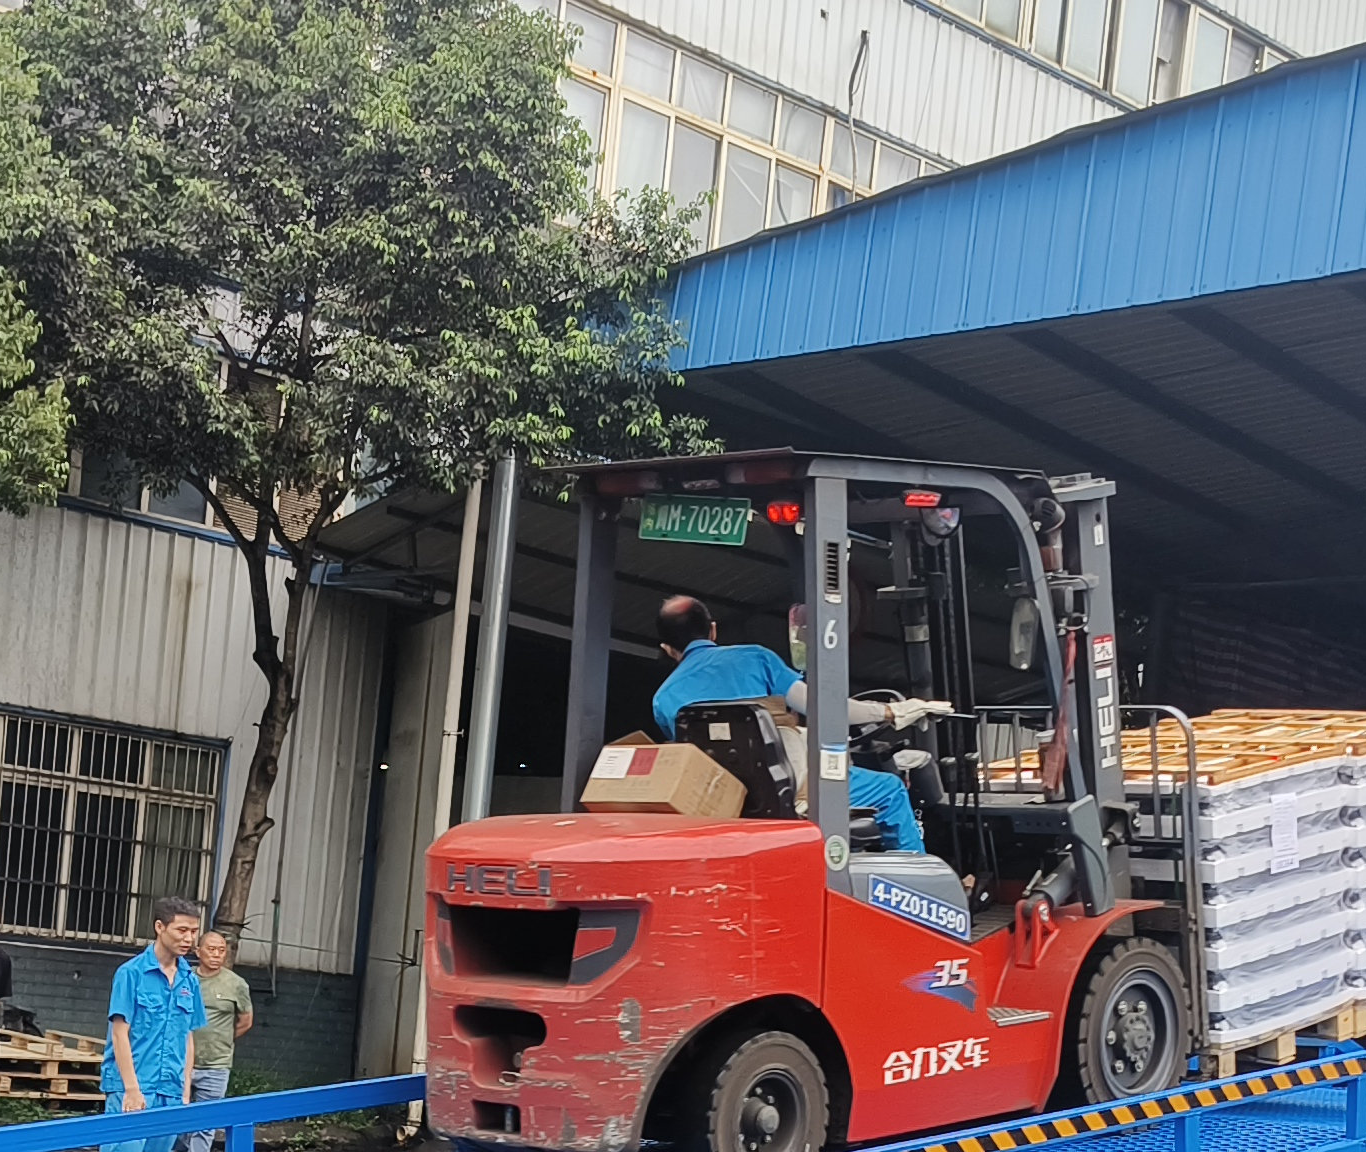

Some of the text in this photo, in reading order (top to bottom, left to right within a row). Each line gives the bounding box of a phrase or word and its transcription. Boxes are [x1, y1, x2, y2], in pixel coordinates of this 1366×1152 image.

[823, 619, 838, 649] 6
[1095, 666, 1117, 769] HELI
[447, 862, 552, 897] HELI
[873, 883, 967, 934] 4-PZ011590
[929, 957, 970, 989] 35
[883, 1036, 990, 1086] 合力叉车
